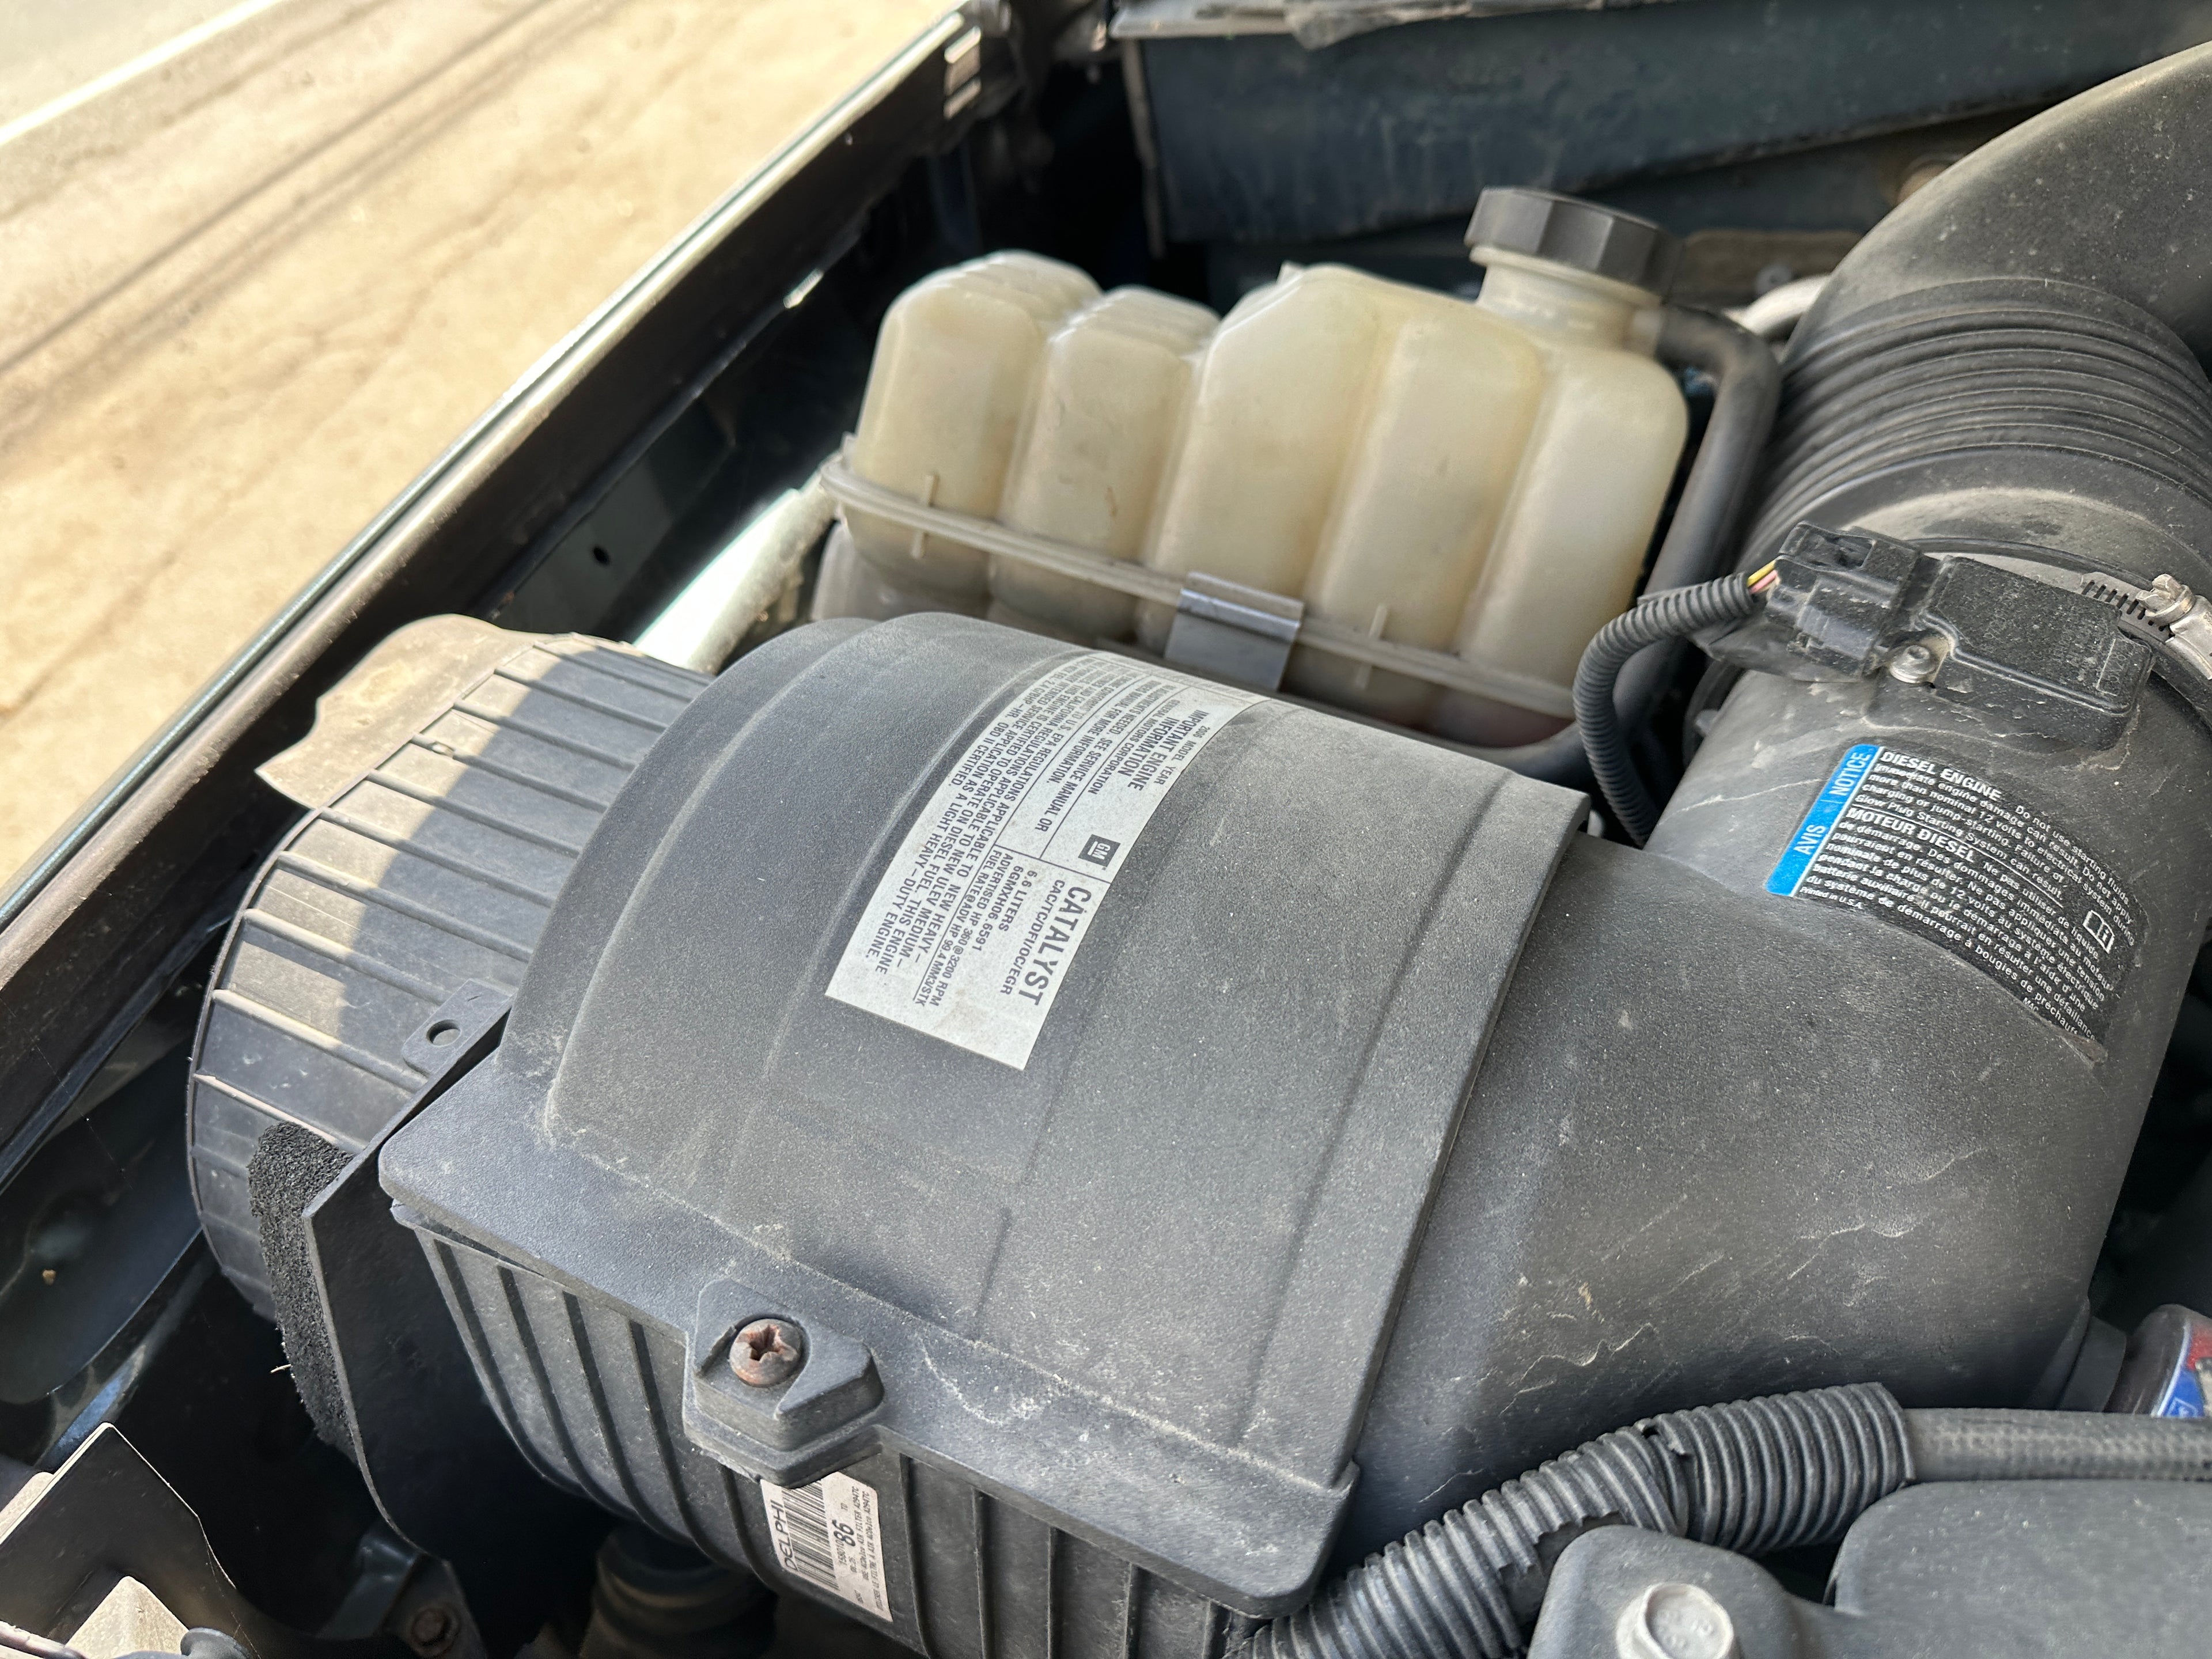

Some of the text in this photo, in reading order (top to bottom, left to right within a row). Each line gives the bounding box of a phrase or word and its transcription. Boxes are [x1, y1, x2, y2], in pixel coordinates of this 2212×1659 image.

[1036, 714, 1050, 722] IS
[1043, 694, 1071, 715] ENGINE
[1046, 695, 1086, 727] CALIFORNIA
[1103, 707, 1122, 719] FOR
[1106, 713, 1137, 735] NEEDED.
[1152, 699, 1181, 718] GENERAL
[989, 722, 1009, 737] OBD
[1006, 721, 1043, 756] CERTIFIED
[1087, 718, 1112, 736] MORE
[1093, 737, 1113, 751] SEE
[1117, 717, 1180, 777] INFORMATION
[1129, 718, 1158, 743] MOTORS
[948, 744, 989, 786] CERTIFIED.
[996, 757, 1013, 768] TO
[1005, 726, 1054, 777] REGULATIONS
[1046, 734, 1096, 783] INFORMATION.
[1069, 751, 1102, 782] SERVICE
[1088, 743, 1135, 795] CORPORATION
[1127, 710, 1209, 791] IMPORTANT ENGINE
[1153, 725, 1211, 785] 2006 MODEL YEAR
[967, 768, 1003, 809] OPERATE
[968, 777, 1012, 832] APPLICABLE
[1044, 781, 1078, 816] MANUAL
[1793, 752, 1872, 855] AVIS NOTICE
[865, 681, 1070, 958] INTENDED SERVICE APPLICATION AS A LIGHT ENGINE.
[939, 711, 1087, 912] TO U.S. EPA REGULATIONS APPLICABLE TO NEW
[956, 809, 974, 825] ON
[1035, 818, 1052, 832] OR
[1861, 784, 1914, 804] charging
[1916, 799, 1931, 807] or
[2014, 844, 2051, 873] Failure
[1880, 751, 1936, 775] DIESEL
[2015, 805, 2031, 819] Do
[2032, 817, 2051, 832] not
[2052, 831, 2071, 847] use
[2071, 846, 2107, 880] starting
[933, 825, 964, 860] DIESEL
[959, 834, 976, 847] TO
[983, 850, 1002, 870] FUEL
[1092, 843, 1111, 861] GM
[1868, 774, 1899, 786] more
[1901, 781, 1927, 794] than
[1929, 791, 1977, 814] nominal
[1979, 811, 1995, 824] 12
[1996, 820, 2022, 839] volts
[2024, 836, 2035, 847] to
[2037, 847, 2082, 884] electrical
[2082, 882, 2112, 915] system
[1887, 801, 1915, 817] Plug
[1916, 811, 1964, 838] Starting
[1964, 832, 2008, 859] System
[2010, 858, 2030, 874] can
[2032, 873, 2063, 900] result.
[1938, 783, 2133, 925] engine damage can Do not apply
[914, 863, 941, 893] FUEL.
[942, 849, 965, 875] NEW
[1845, 807, 2070, 929] MOTEUR DIESEL Ne pas utiliser de
[926, 876, 949, 907] ULEV
[972, 865, 1024, 951] 6GMXH06.6591
[998, 870, 1038, 931] 6.6 LITERS
[1799, 886, 1830, 898] Printed
[1838, 821, 1857, 831] de
[1856, 825, 1923, 853] démarrage.
[1927, 848, 1950, 864] Des
[1953, 862, 2015, 902] dommages
[2070, 942, 2081, 957] au
[1883, 858, 2012, 929] de plus de 12 volts au
[1885, 873, 1929, 895] charge
[1929, 892, 1946, 903] ou
[1948, 899, 1961, 910] le
[1897, 851, 1914, 861] en
[1967, 881, 1984, 895] Ne
[1984, 893, 2006, 910] pas
[2008, 908, 2056, 948] appliquer
[2058, 948, 2077, 967] une
[899, 899, 922, 926] THIS
[929, 853, 1014, 1006] ADVERTISED HP RPM
[949, 923, 963, 938] HP
[875, 928, 906, 975] ENGINE
[937, 939, 953, 960] 99.4
[1000, 879, 1066, 995] CAC/TC/DFI/OC/EGR
[1018, 887, 1092, 1006] CATALYST
[1805, 875, 2033, 993] du système démarrage à bougies de
[915, 960, 944, 1007] MM3/STK
[1978, 933, 1993, 946] en
[2035, 975, 2052, 994] une
[770, 1499, 797, 1571] DELPHI
[854, 1510, 863, 1532] FILTER
